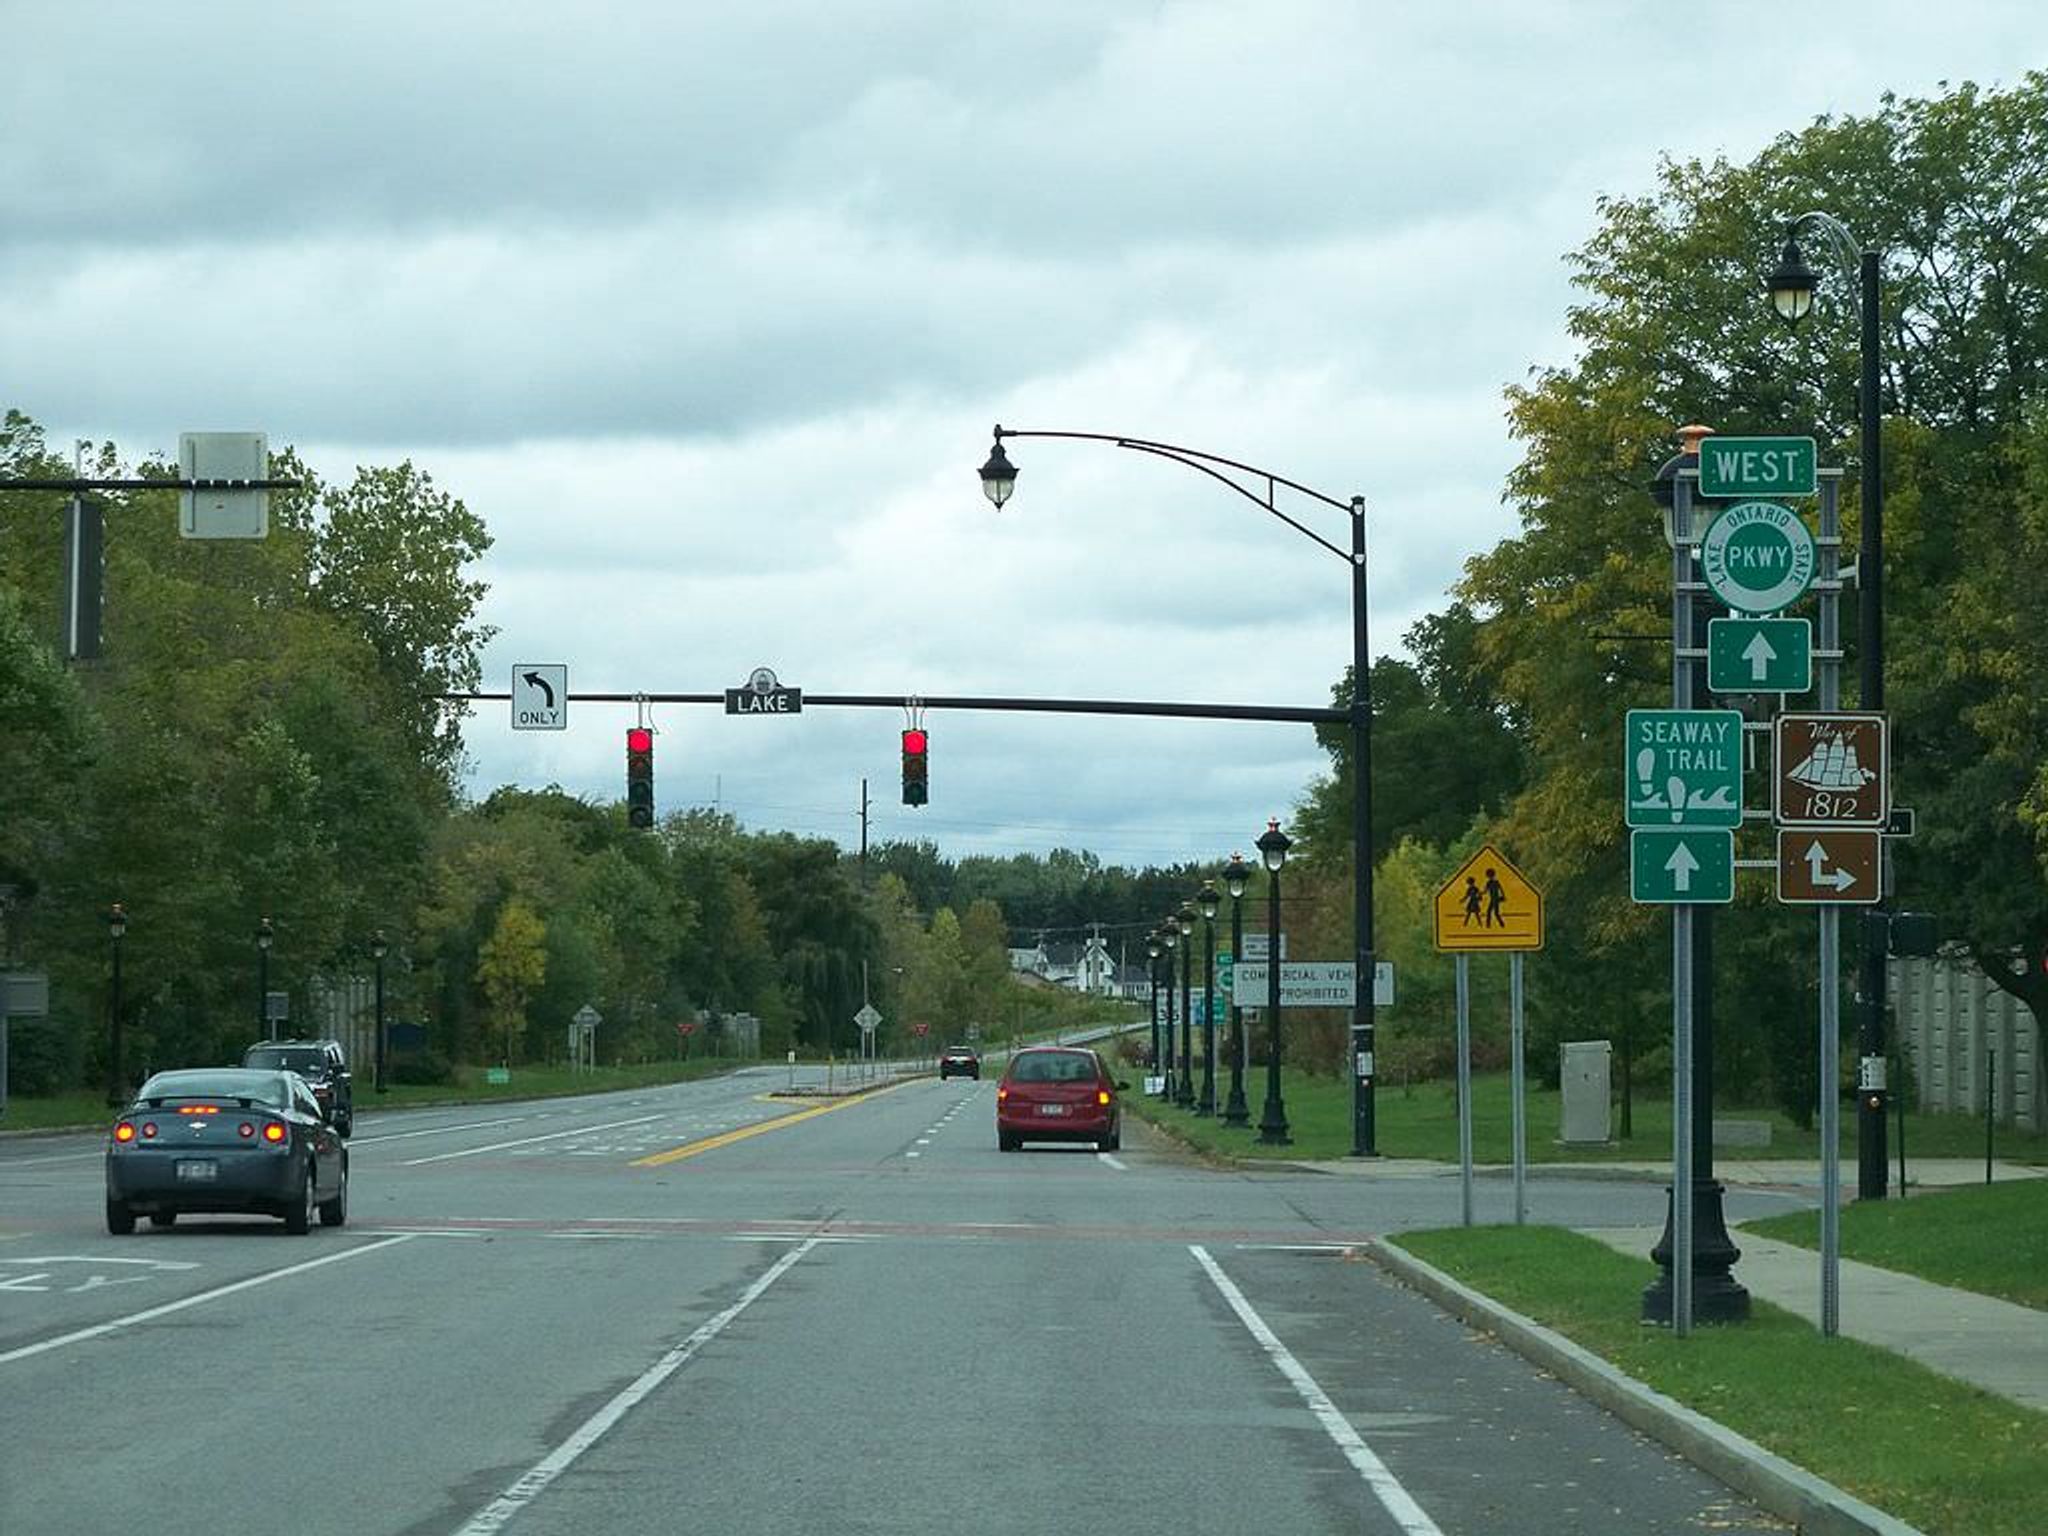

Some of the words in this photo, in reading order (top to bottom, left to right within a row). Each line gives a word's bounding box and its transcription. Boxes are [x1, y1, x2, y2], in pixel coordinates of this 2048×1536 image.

[1715, 451, 1800, 483] WEST
[1708, 542, 1728, 588] LAKE
[1725, 505, 1792, 528] ONTARIO
[1790, 543, 1810, 588] STATE
[1729, 545, 1789, 568] PKWY
[737, 694, 789, 712] LAKE
[519, 711, 559, 725] ONLY
[1640, 721, 1730, 744] SEAWAY
[1665, 747, 1729, 771] TRAIL
[1804, 792, 1858, 818] 1812
[1242, 969, 1320, 982] COMRCIAL
